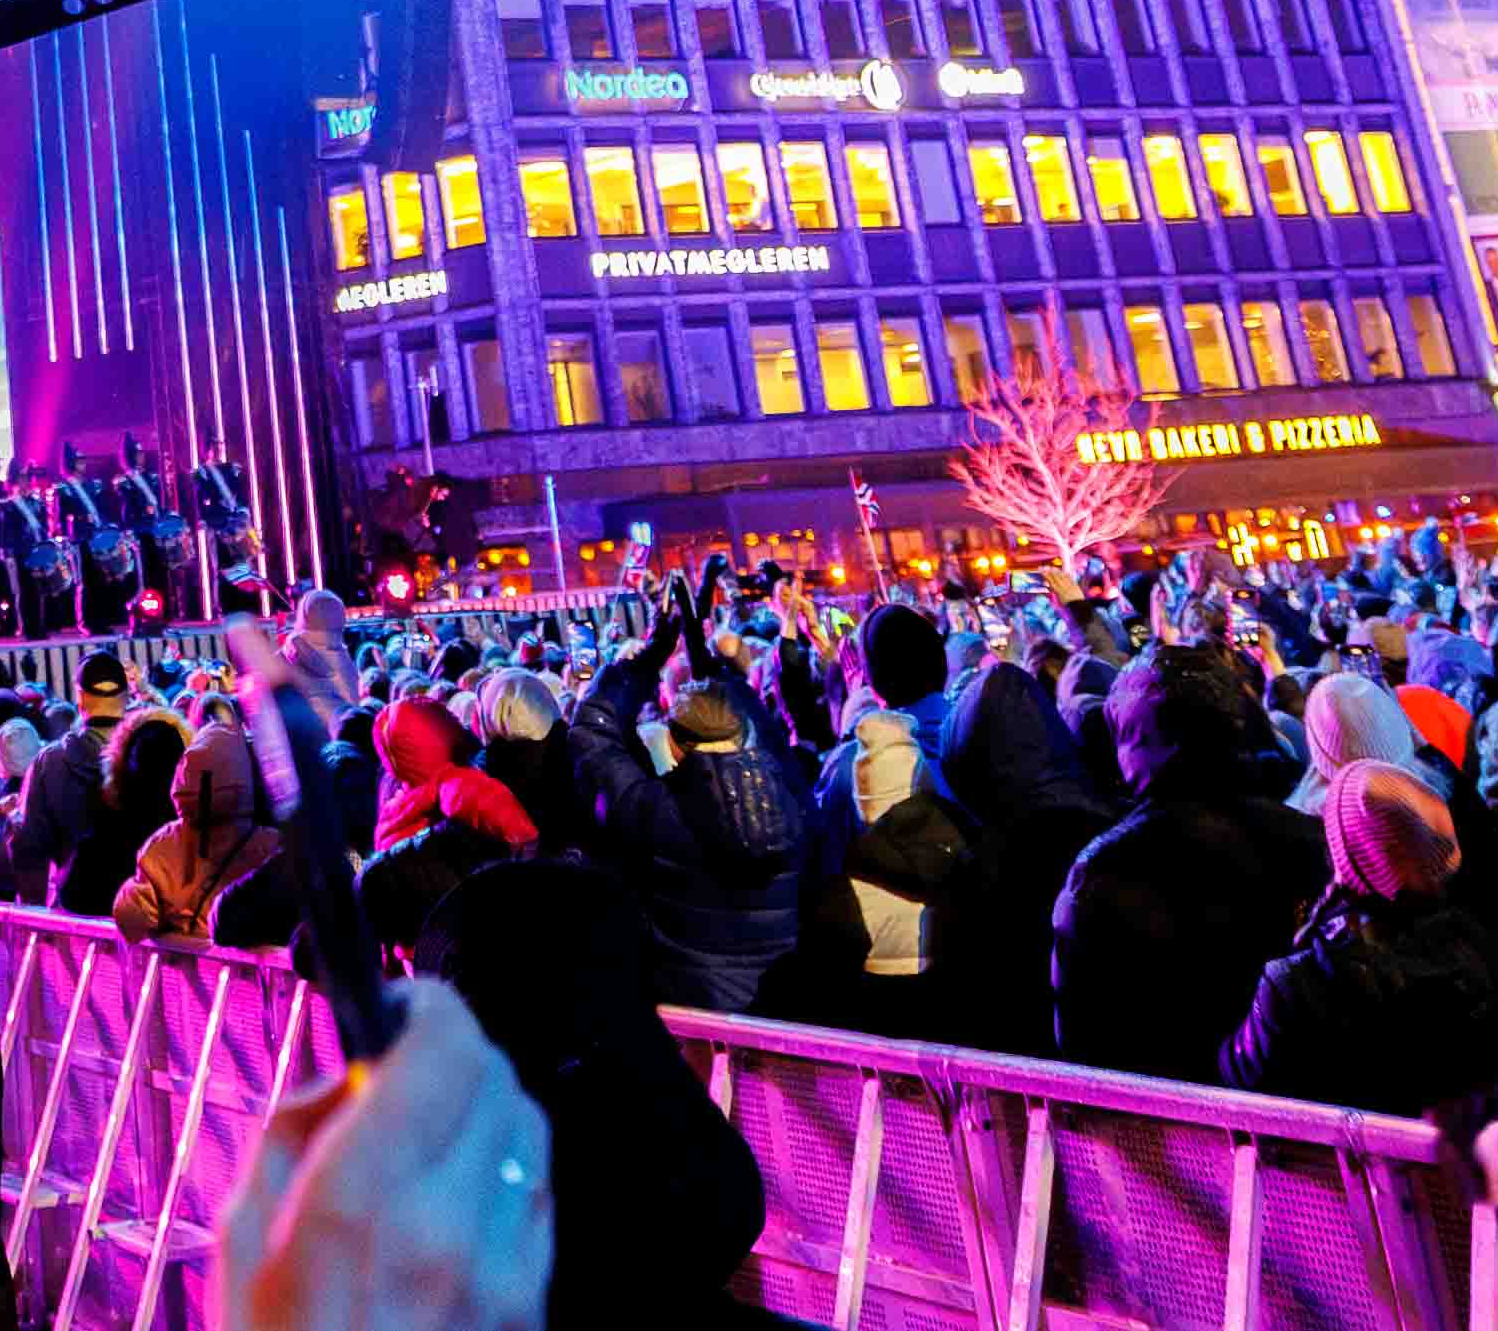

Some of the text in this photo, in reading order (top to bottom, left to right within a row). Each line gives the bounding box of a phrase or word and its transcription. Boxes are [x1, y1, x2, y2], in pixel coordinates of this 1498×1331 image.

[565, 66, 689, 101] Nordea
[591, 246, 830, 279] PRIVATMEGLEREN
[1267, 414, 1382, 451] PIZZERIA
